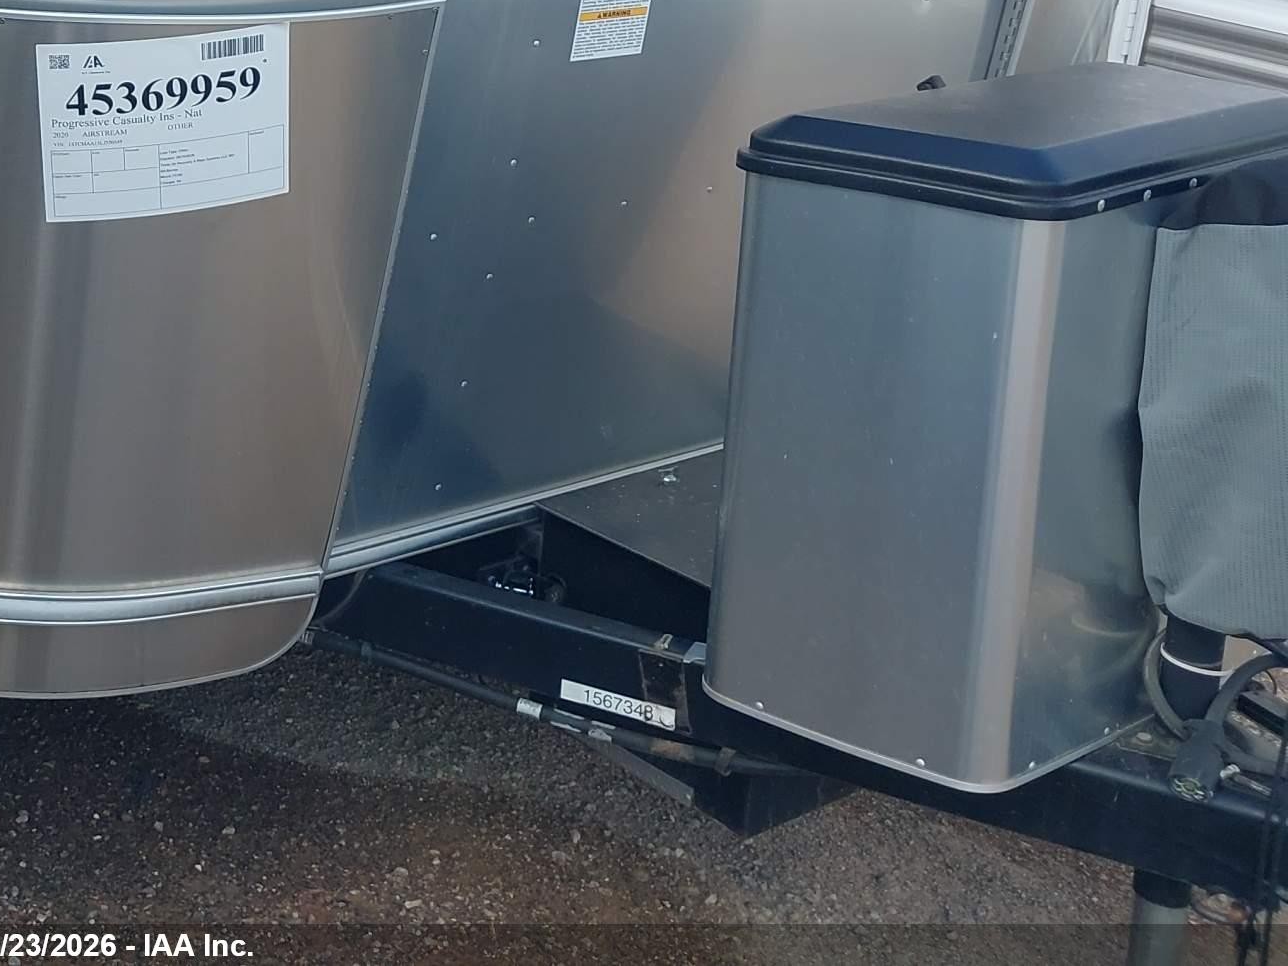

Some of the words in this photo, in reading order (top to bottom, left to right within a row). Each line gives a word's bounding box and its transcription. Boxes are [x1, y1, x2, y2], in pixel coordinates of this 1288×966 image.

[66, 66, 261, 116] 45369959
[51, 117, 109, 130] Progressive
[112, 113, 156, 126] Casualty
[160, 112, 175, 122] Ins
[185, 109, 202, 118] Nat
[82, 129, 127, 138] AIRSTREAM
[167, 122, 193, 130] OTHER
[584, 689, 653, 721] 1567348
